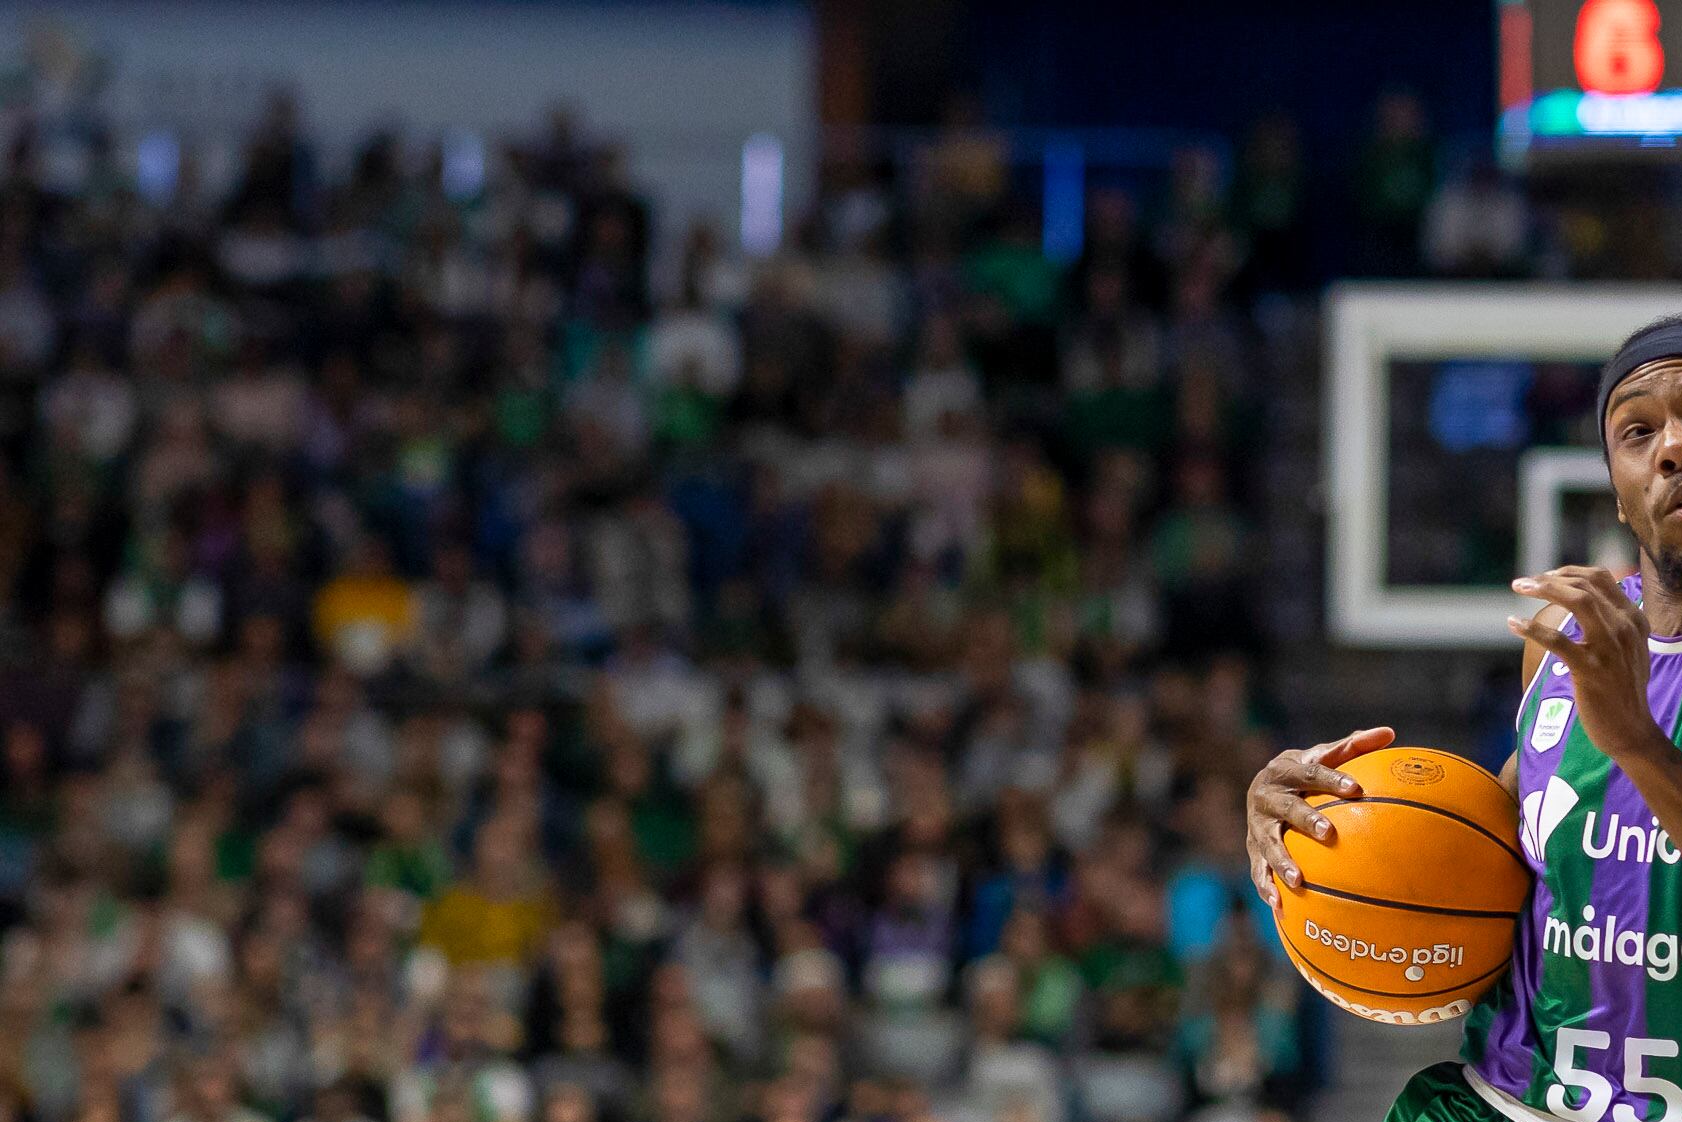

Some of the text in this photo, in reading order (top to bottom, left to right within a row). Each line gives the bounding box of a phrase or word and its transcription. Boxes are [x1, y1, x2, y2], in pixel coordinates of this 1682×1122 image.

[1582, 811, 1681, 864] Unic
[1304, 919, 1464, 968] liga endesa
